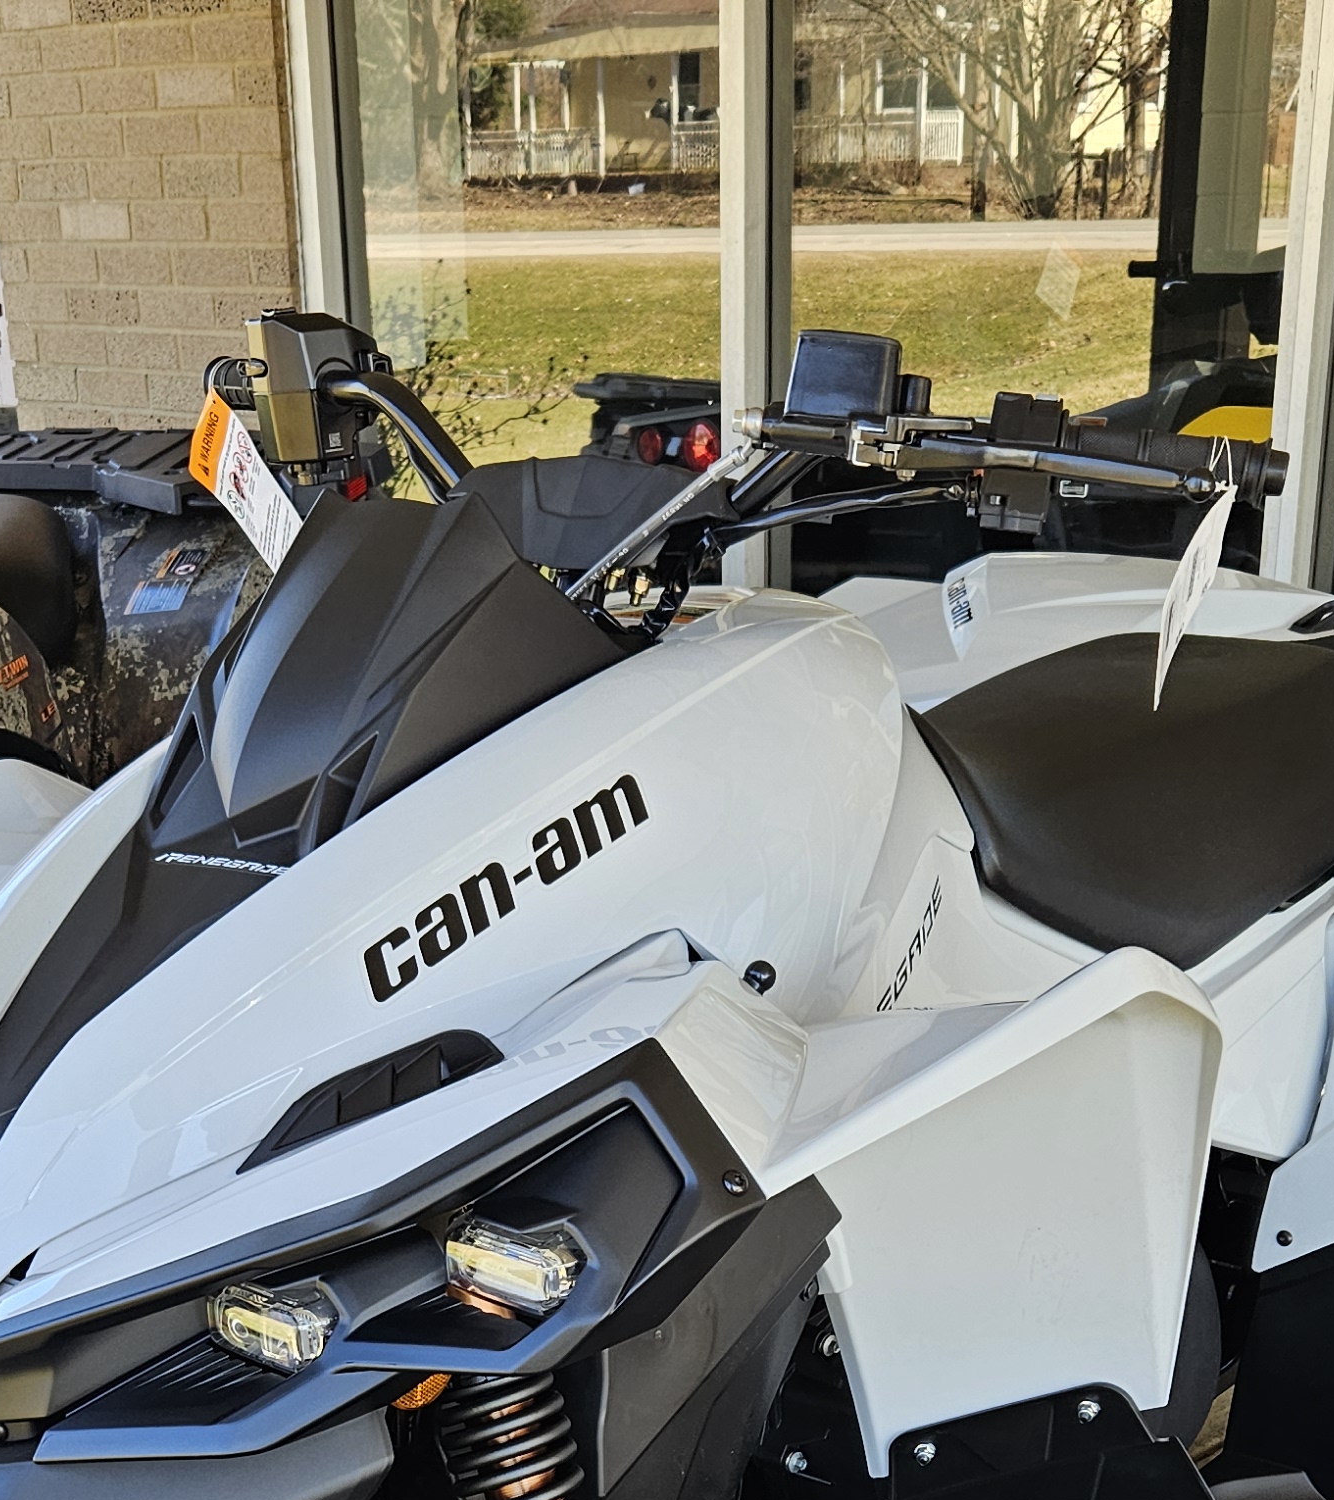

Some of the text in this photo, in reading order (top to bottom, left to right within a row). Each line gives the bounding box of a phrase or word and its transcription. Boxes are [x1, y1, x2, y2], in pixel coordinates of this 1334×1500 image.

[200, 411, 220, 463] WARNING
[947, 576, 974, 630] can-am
[154, 852, 290, 876] RENEGADE
[363, 774, 649, 1003] can-am
